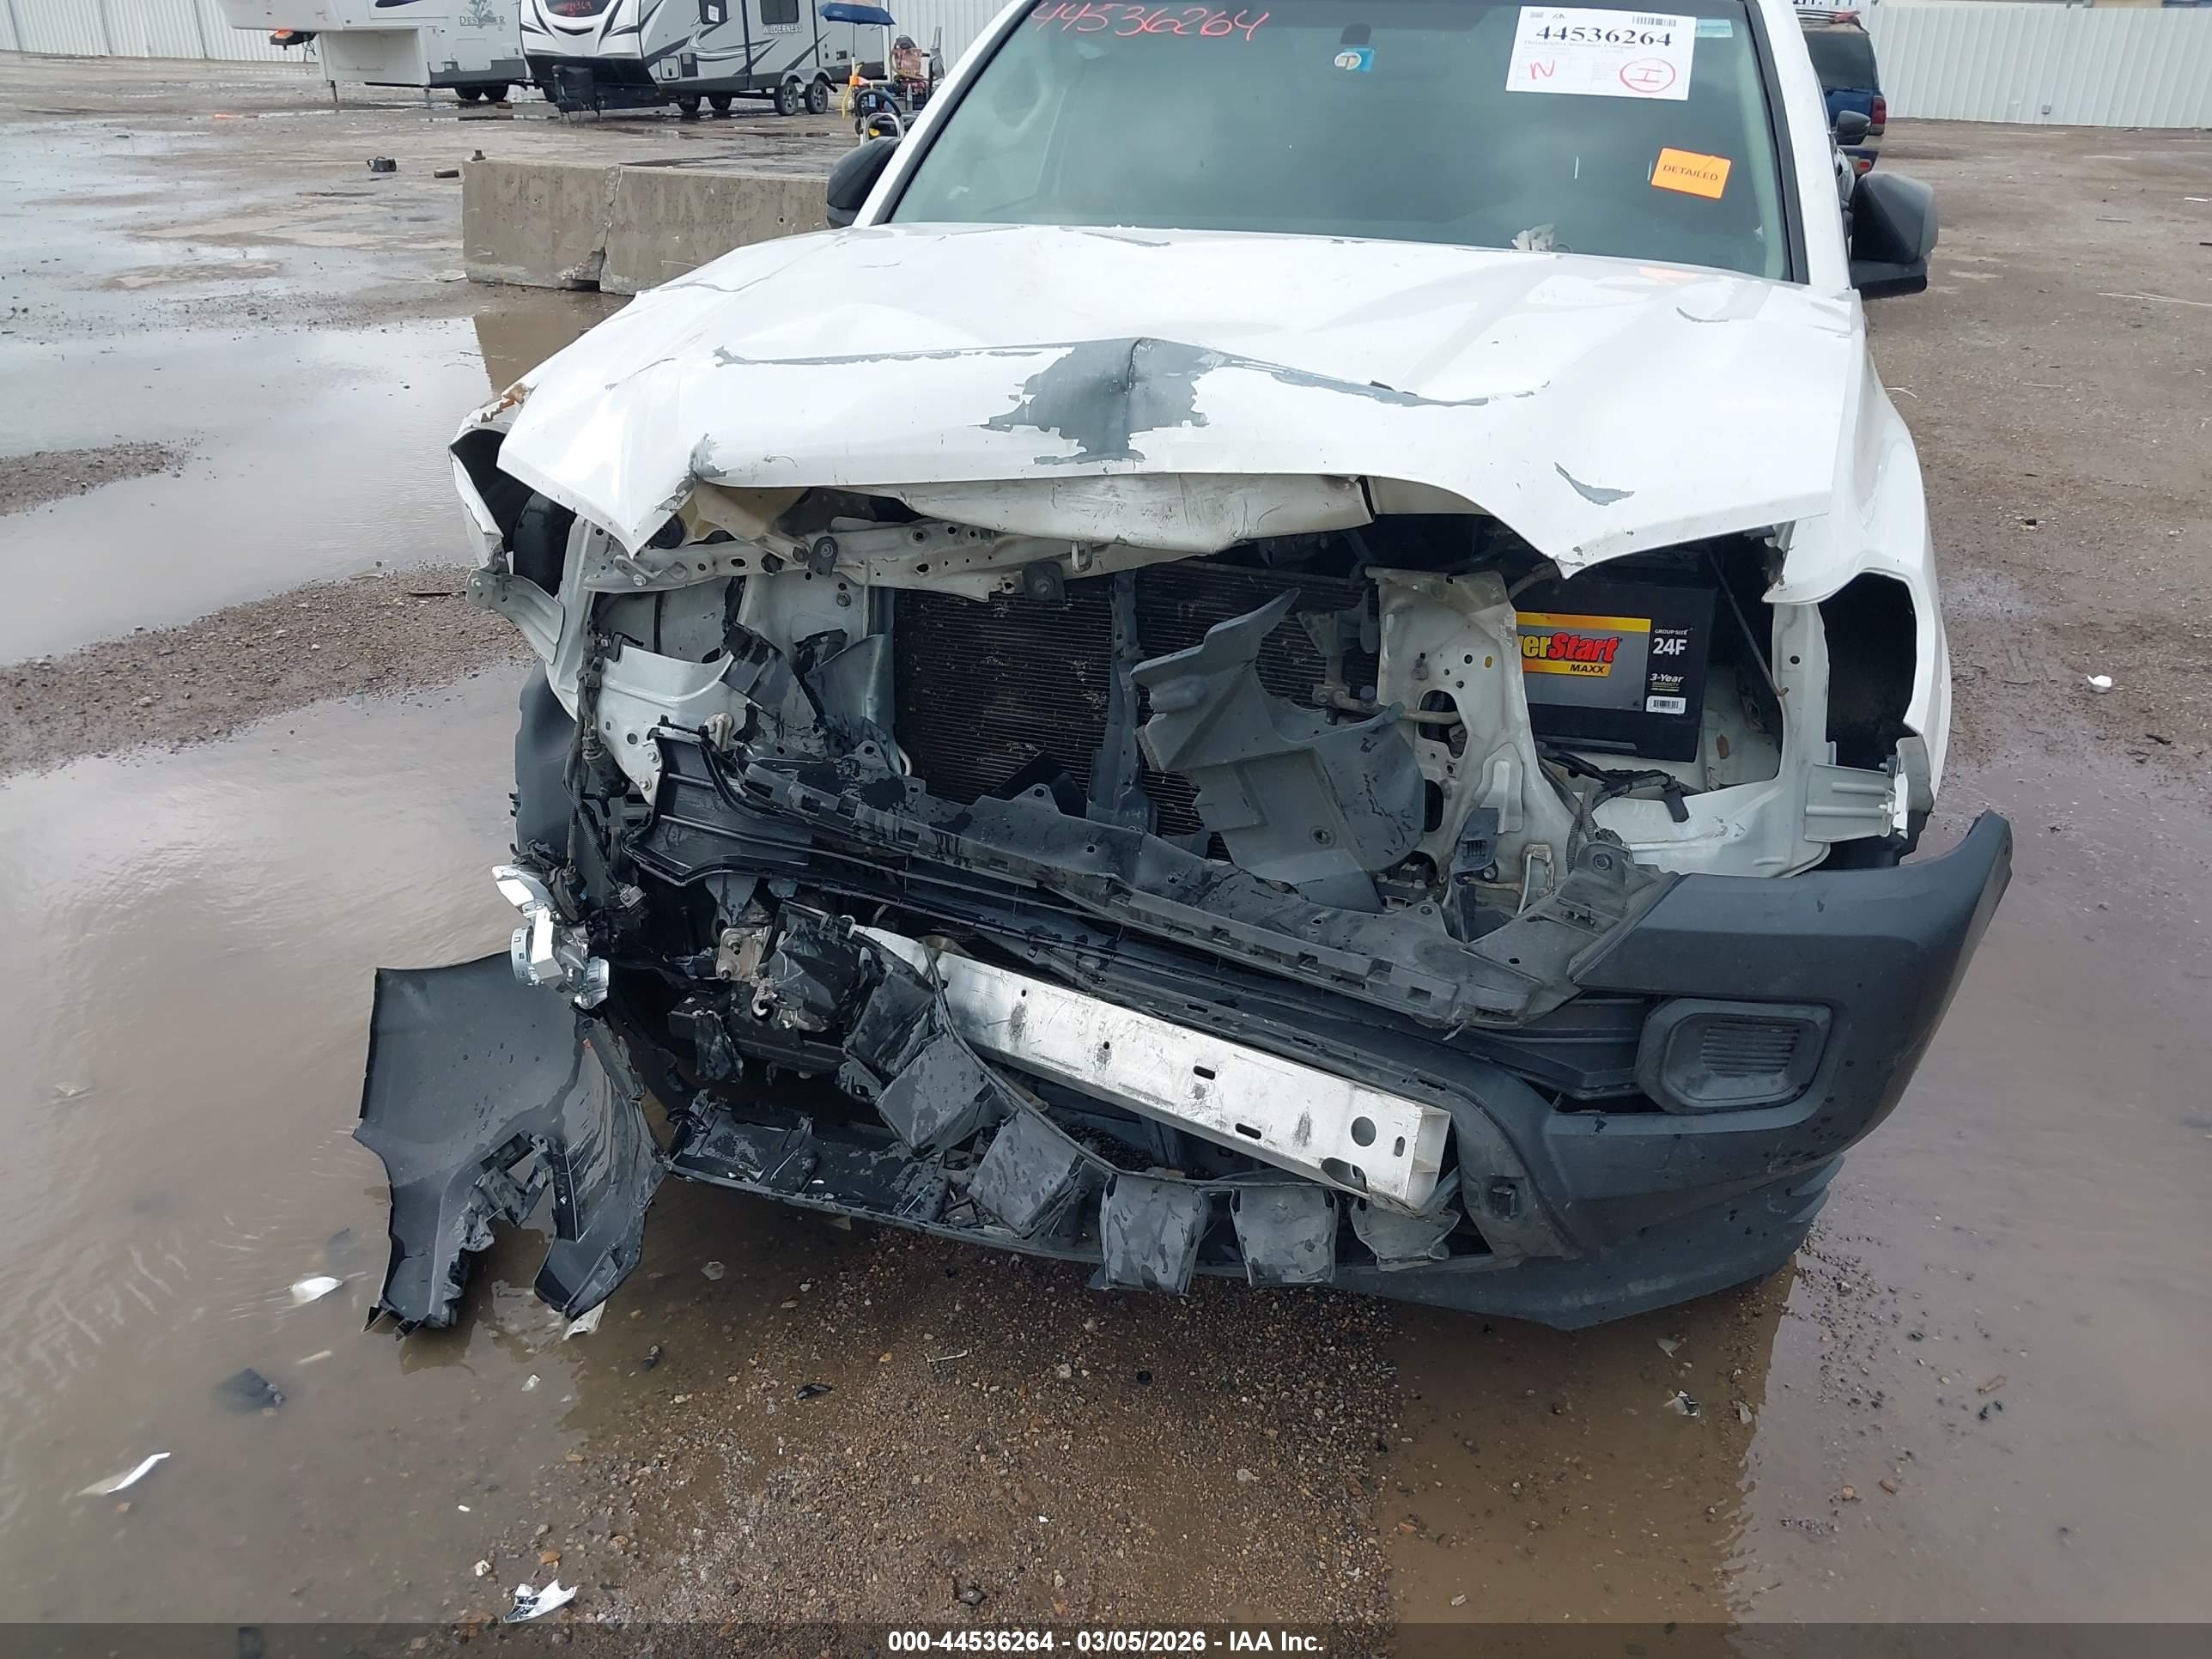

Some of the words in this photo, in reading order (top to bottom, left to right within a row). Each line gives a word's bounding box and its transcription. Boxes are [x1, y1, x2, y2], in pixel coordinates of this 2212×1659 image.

[763, 24, 803, 34] WILDERNESS
[1535, 25, 1672, 46] 44536264
[1530, 59, 1556, 80] N
[1662, 164, 1718, 180] DETAILED
[1653, 637, 1687, 655] 24F
[1570, 664, 1605, 674] MAXX
[1650, 673, 1684, 683] 3-Year
